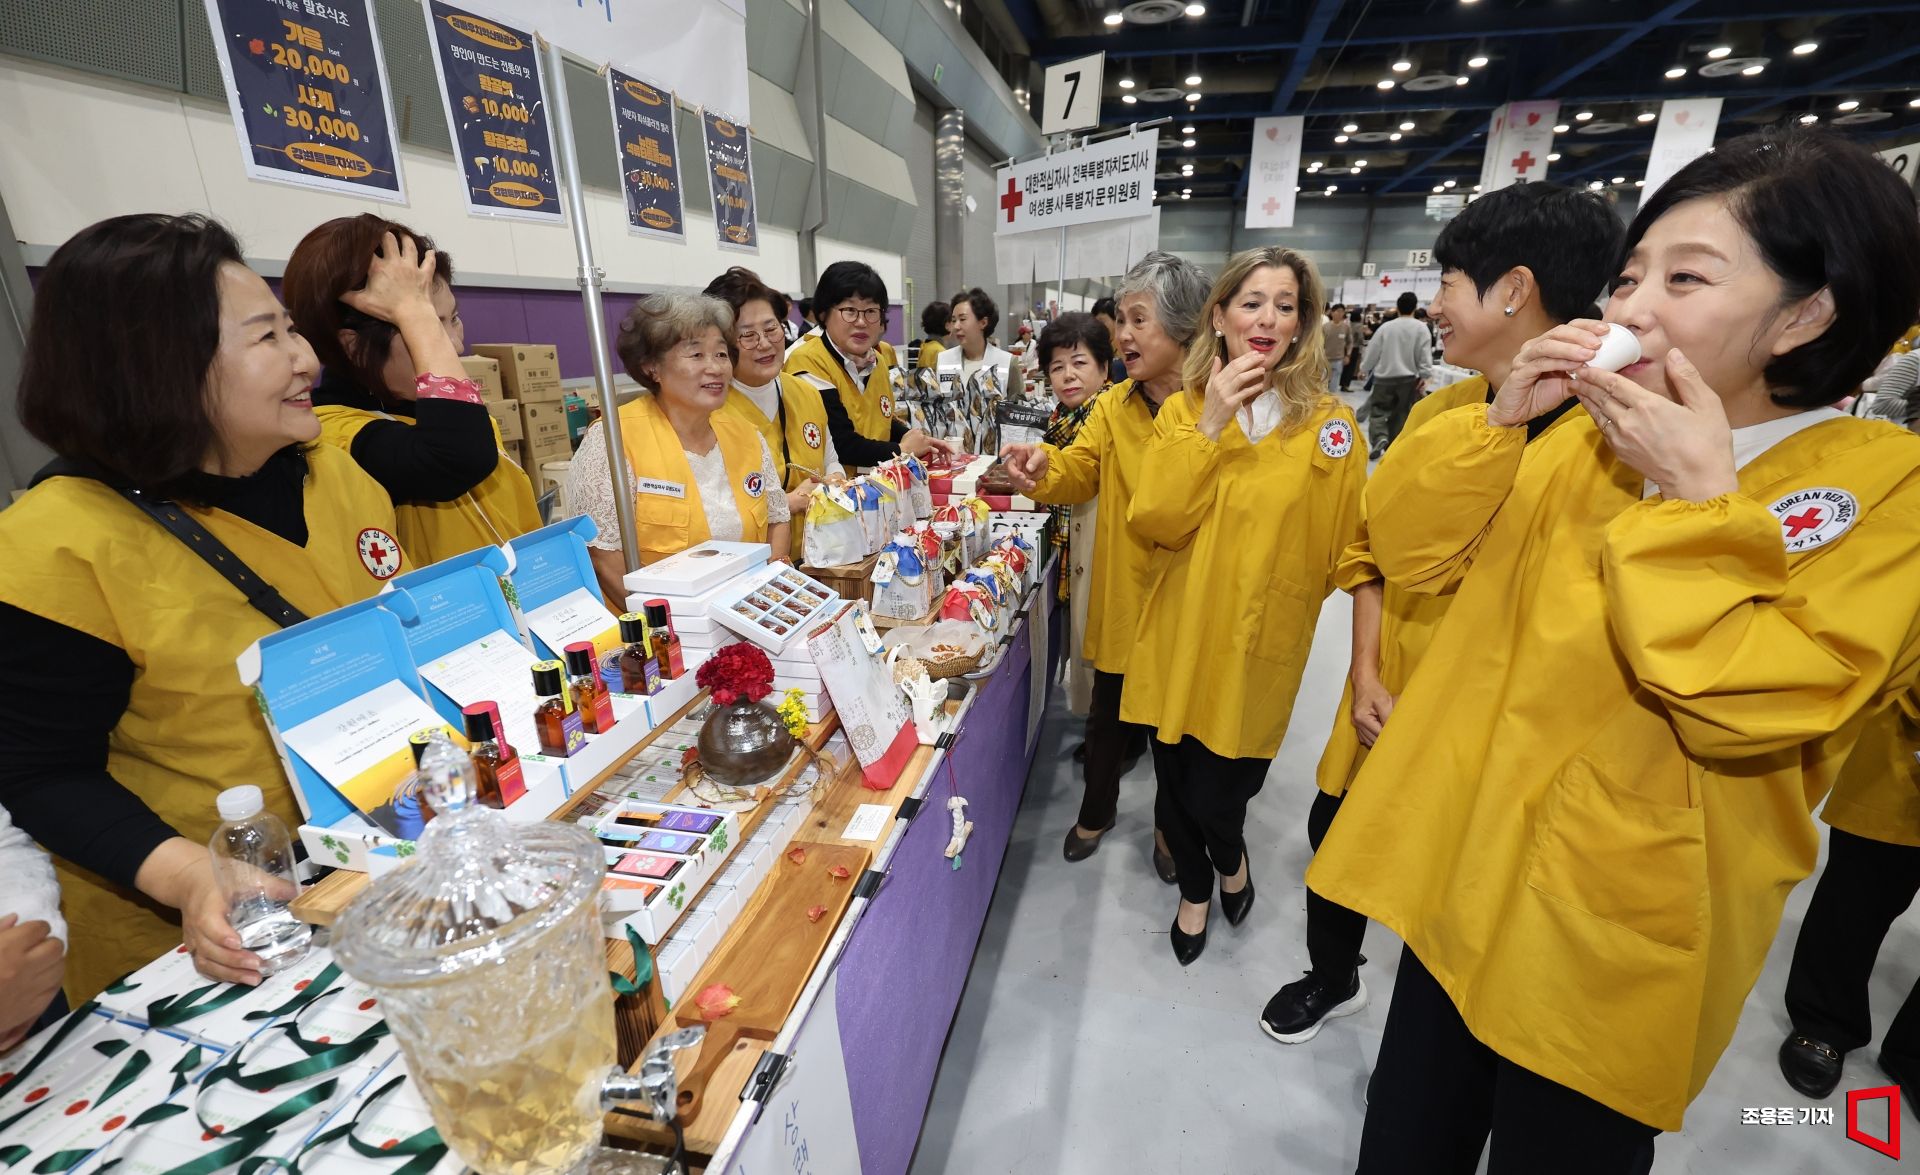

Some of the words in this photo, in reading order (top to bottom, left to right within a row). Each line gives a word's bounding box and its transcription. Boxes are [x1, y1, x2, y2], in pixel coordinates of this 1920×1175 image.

[271, 43, 350, 84] 20,000
[450, 44, 477, 63] 명인이
[476, 52, 500, 70] 만드는
[500, 60, 523, 77] 전통의
[523, 66, 531, 80] 맛
[298, 84, 336, 113] 사계
[481, 97, 529, 124] 10,000
[1064, 70, 1082, 121] 7
[283, 106, 361, 142] 30,000
[291, 147, 367, 173] 강원특별자치도
[493, 156, 540, 178] 10,000
[1025, 164, 1072, 196] 대한적십자사
[1072, 149, 1150, 184] 전북특별자치도지사
[641, 171, 671, 191] 30,000
[1028, 180, 1142, 217] 여성봉사특별자문위원회
[1412, 252, 1428, 264] 15
[1774, 491, 1821, 513] KOREAN
[1821, 492, 1843, 503] RED
[1834, 500, 1851, 523] CROSS
